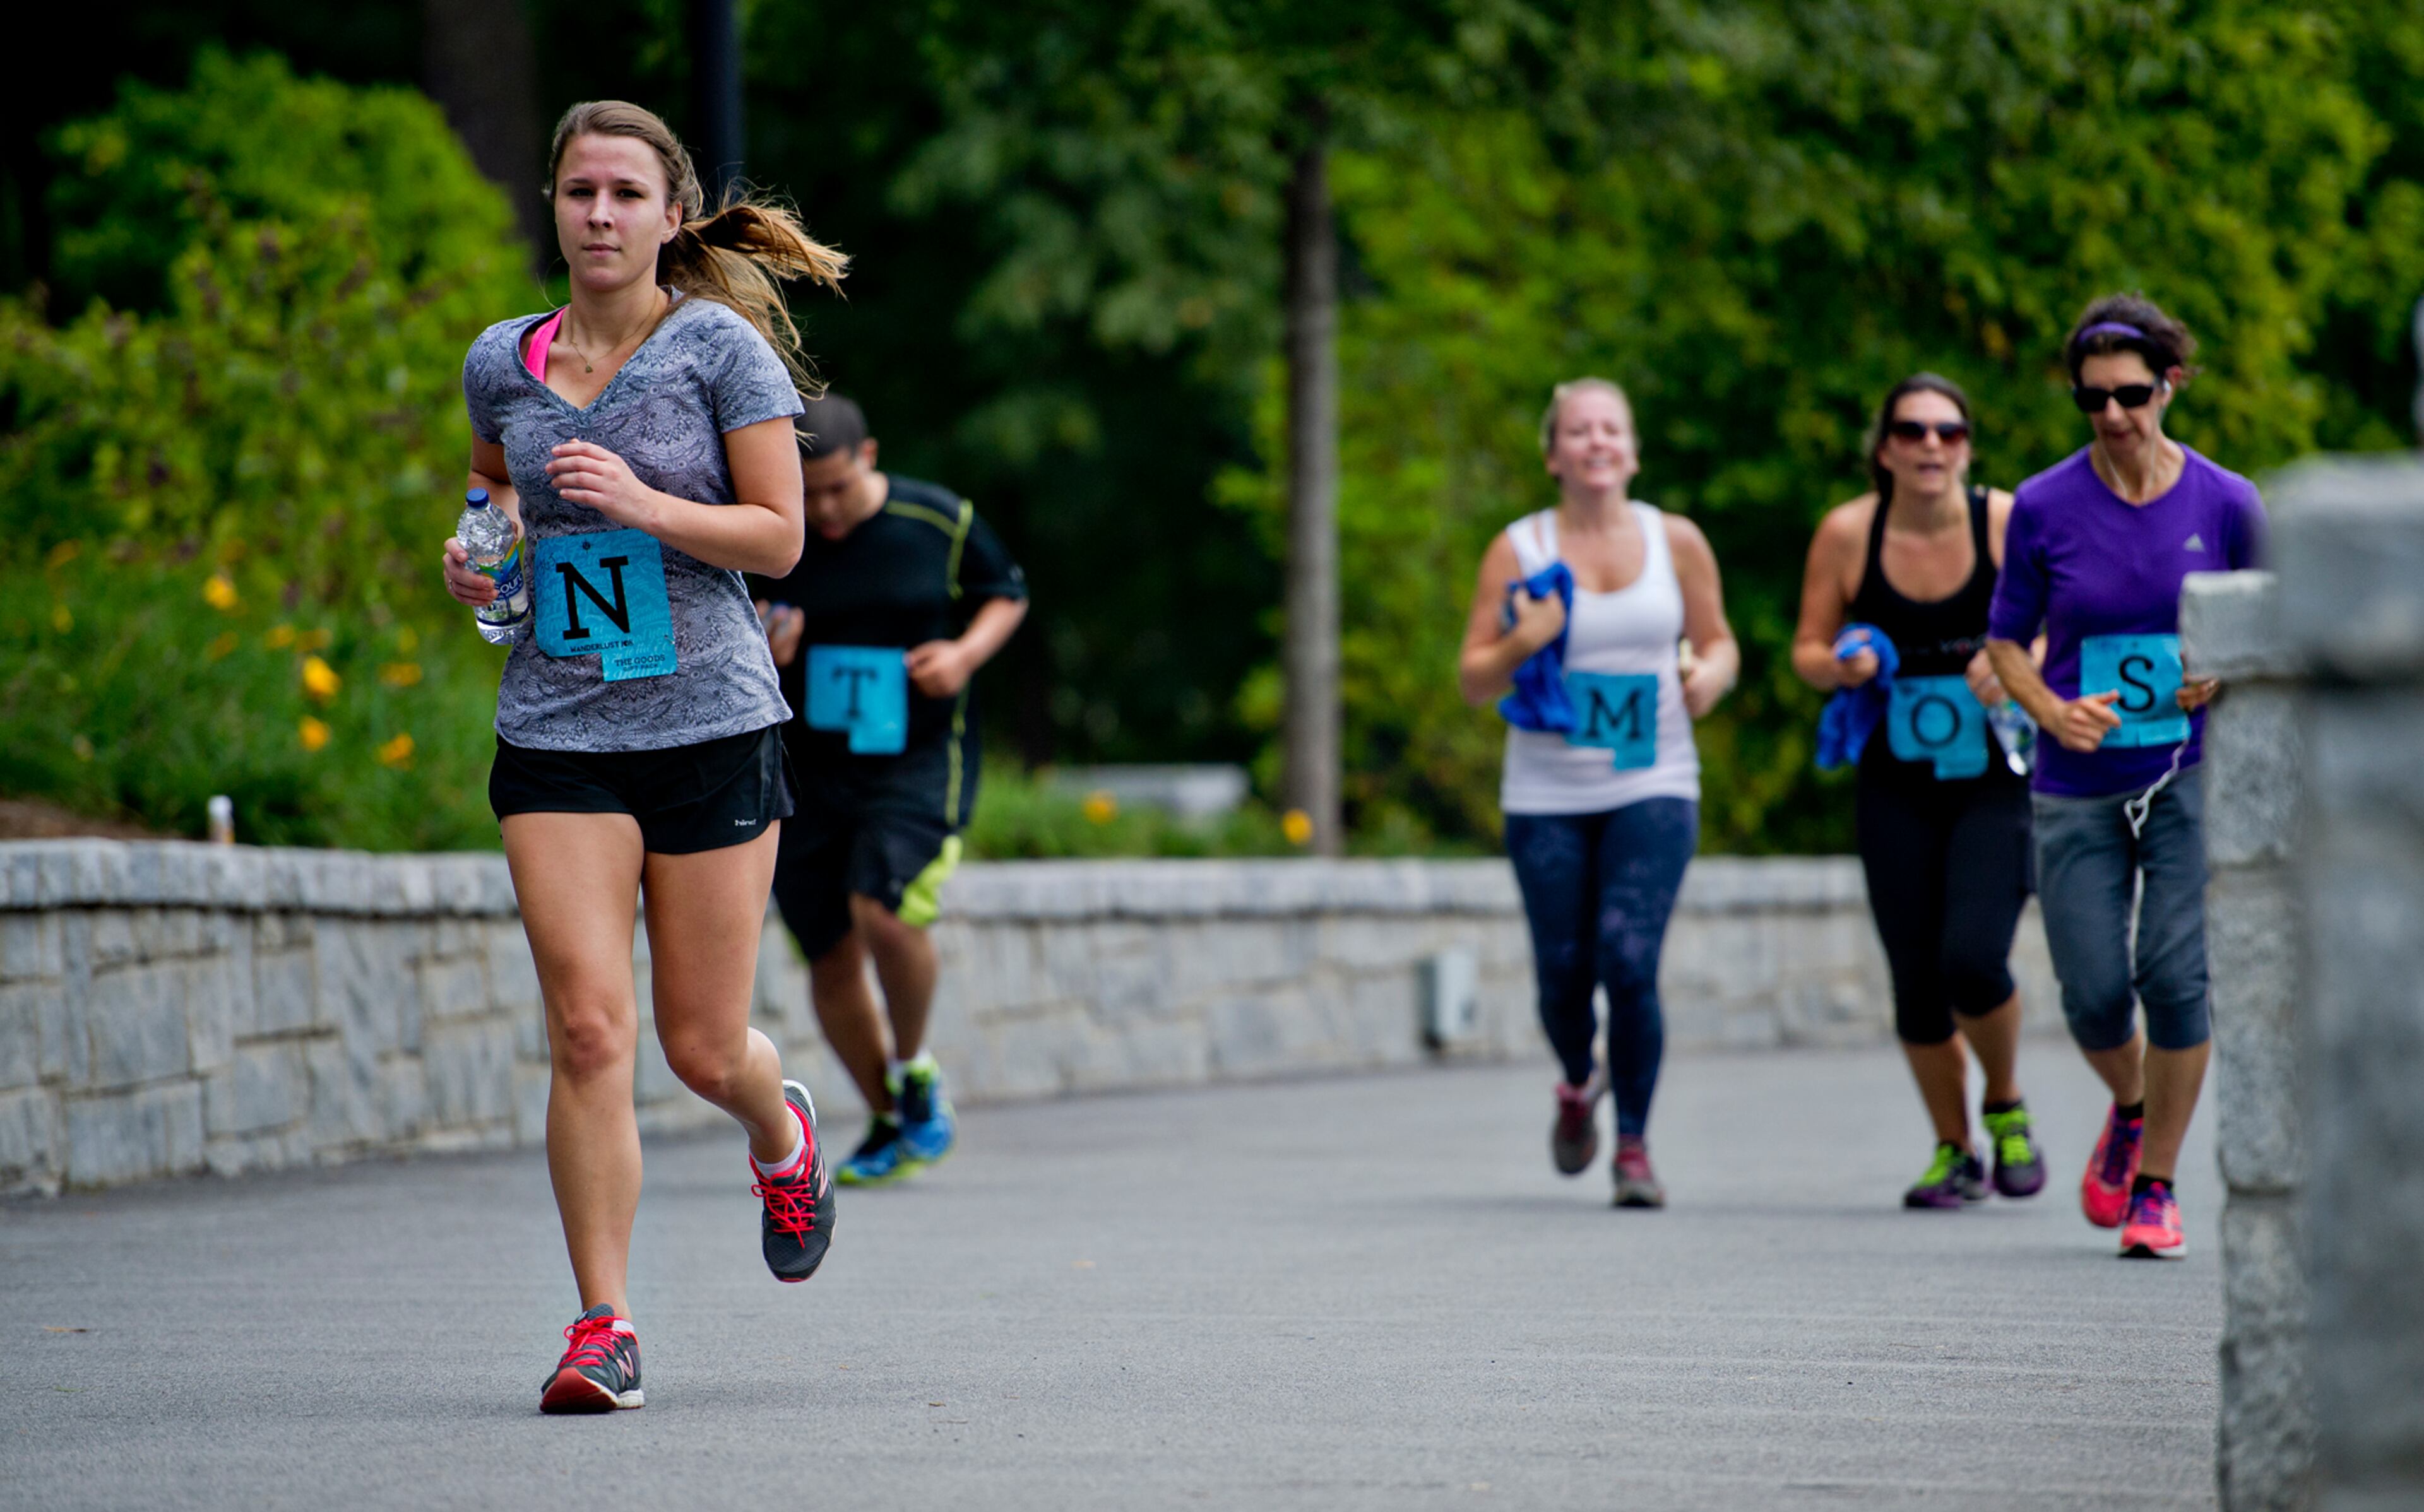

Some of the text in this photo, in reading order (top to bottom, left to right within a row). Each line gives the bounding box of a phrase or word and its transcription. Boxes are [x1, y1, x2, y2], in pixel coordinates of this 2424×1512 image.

[556, 555, 630, 640] N
[570, 641, 619, 653] WANDERLUST
[614, 654, 665, 666] THE GOODS
[831, 666, 879, 721] T
[2117, 654, 2156, 713] S
[1584, 686, 1644, 741] M
[1910, 695, 1961, 748] O
